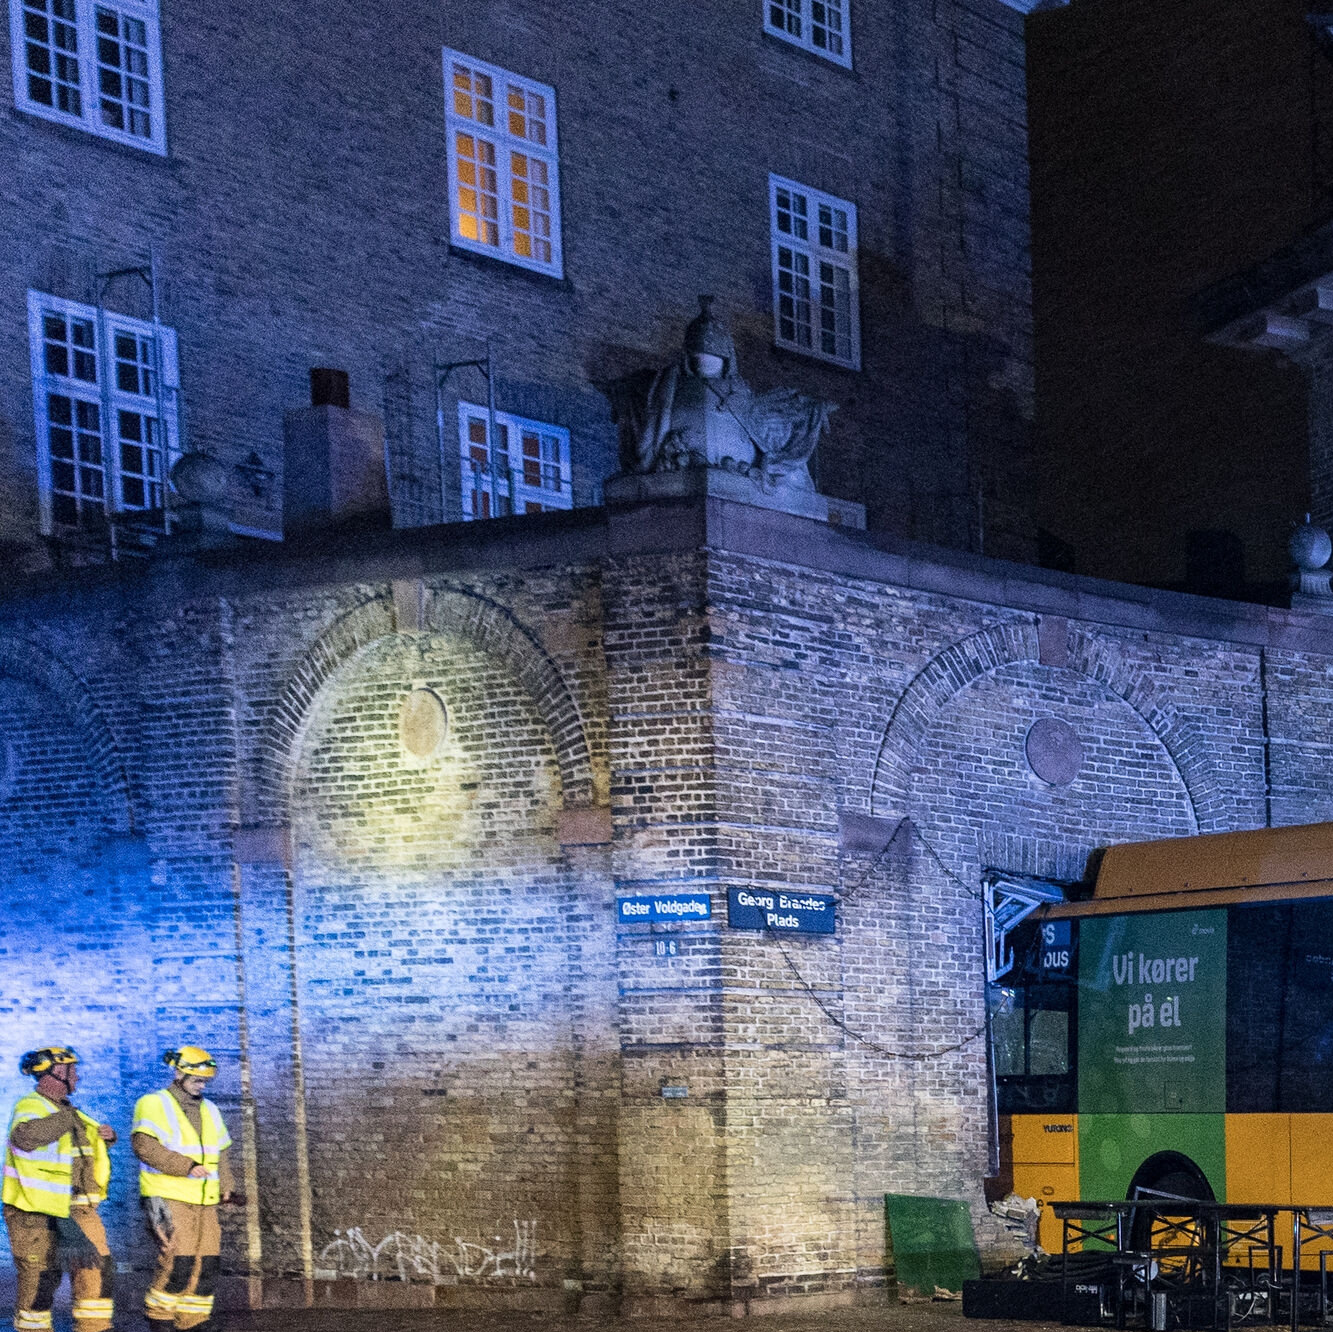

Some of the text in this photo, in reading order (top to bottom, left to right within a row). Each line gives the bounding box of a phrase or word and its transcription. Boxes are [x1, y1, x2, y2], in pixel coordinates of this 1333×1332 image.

[622, 901, 651, 915] Øster
[738, 892, 826, 911] Georg Brandes
[767, 913, 800, 928] Plads
[1112, 951, 1199, 985] Vi kører
[1128, 993, 1181, 1035] på el
